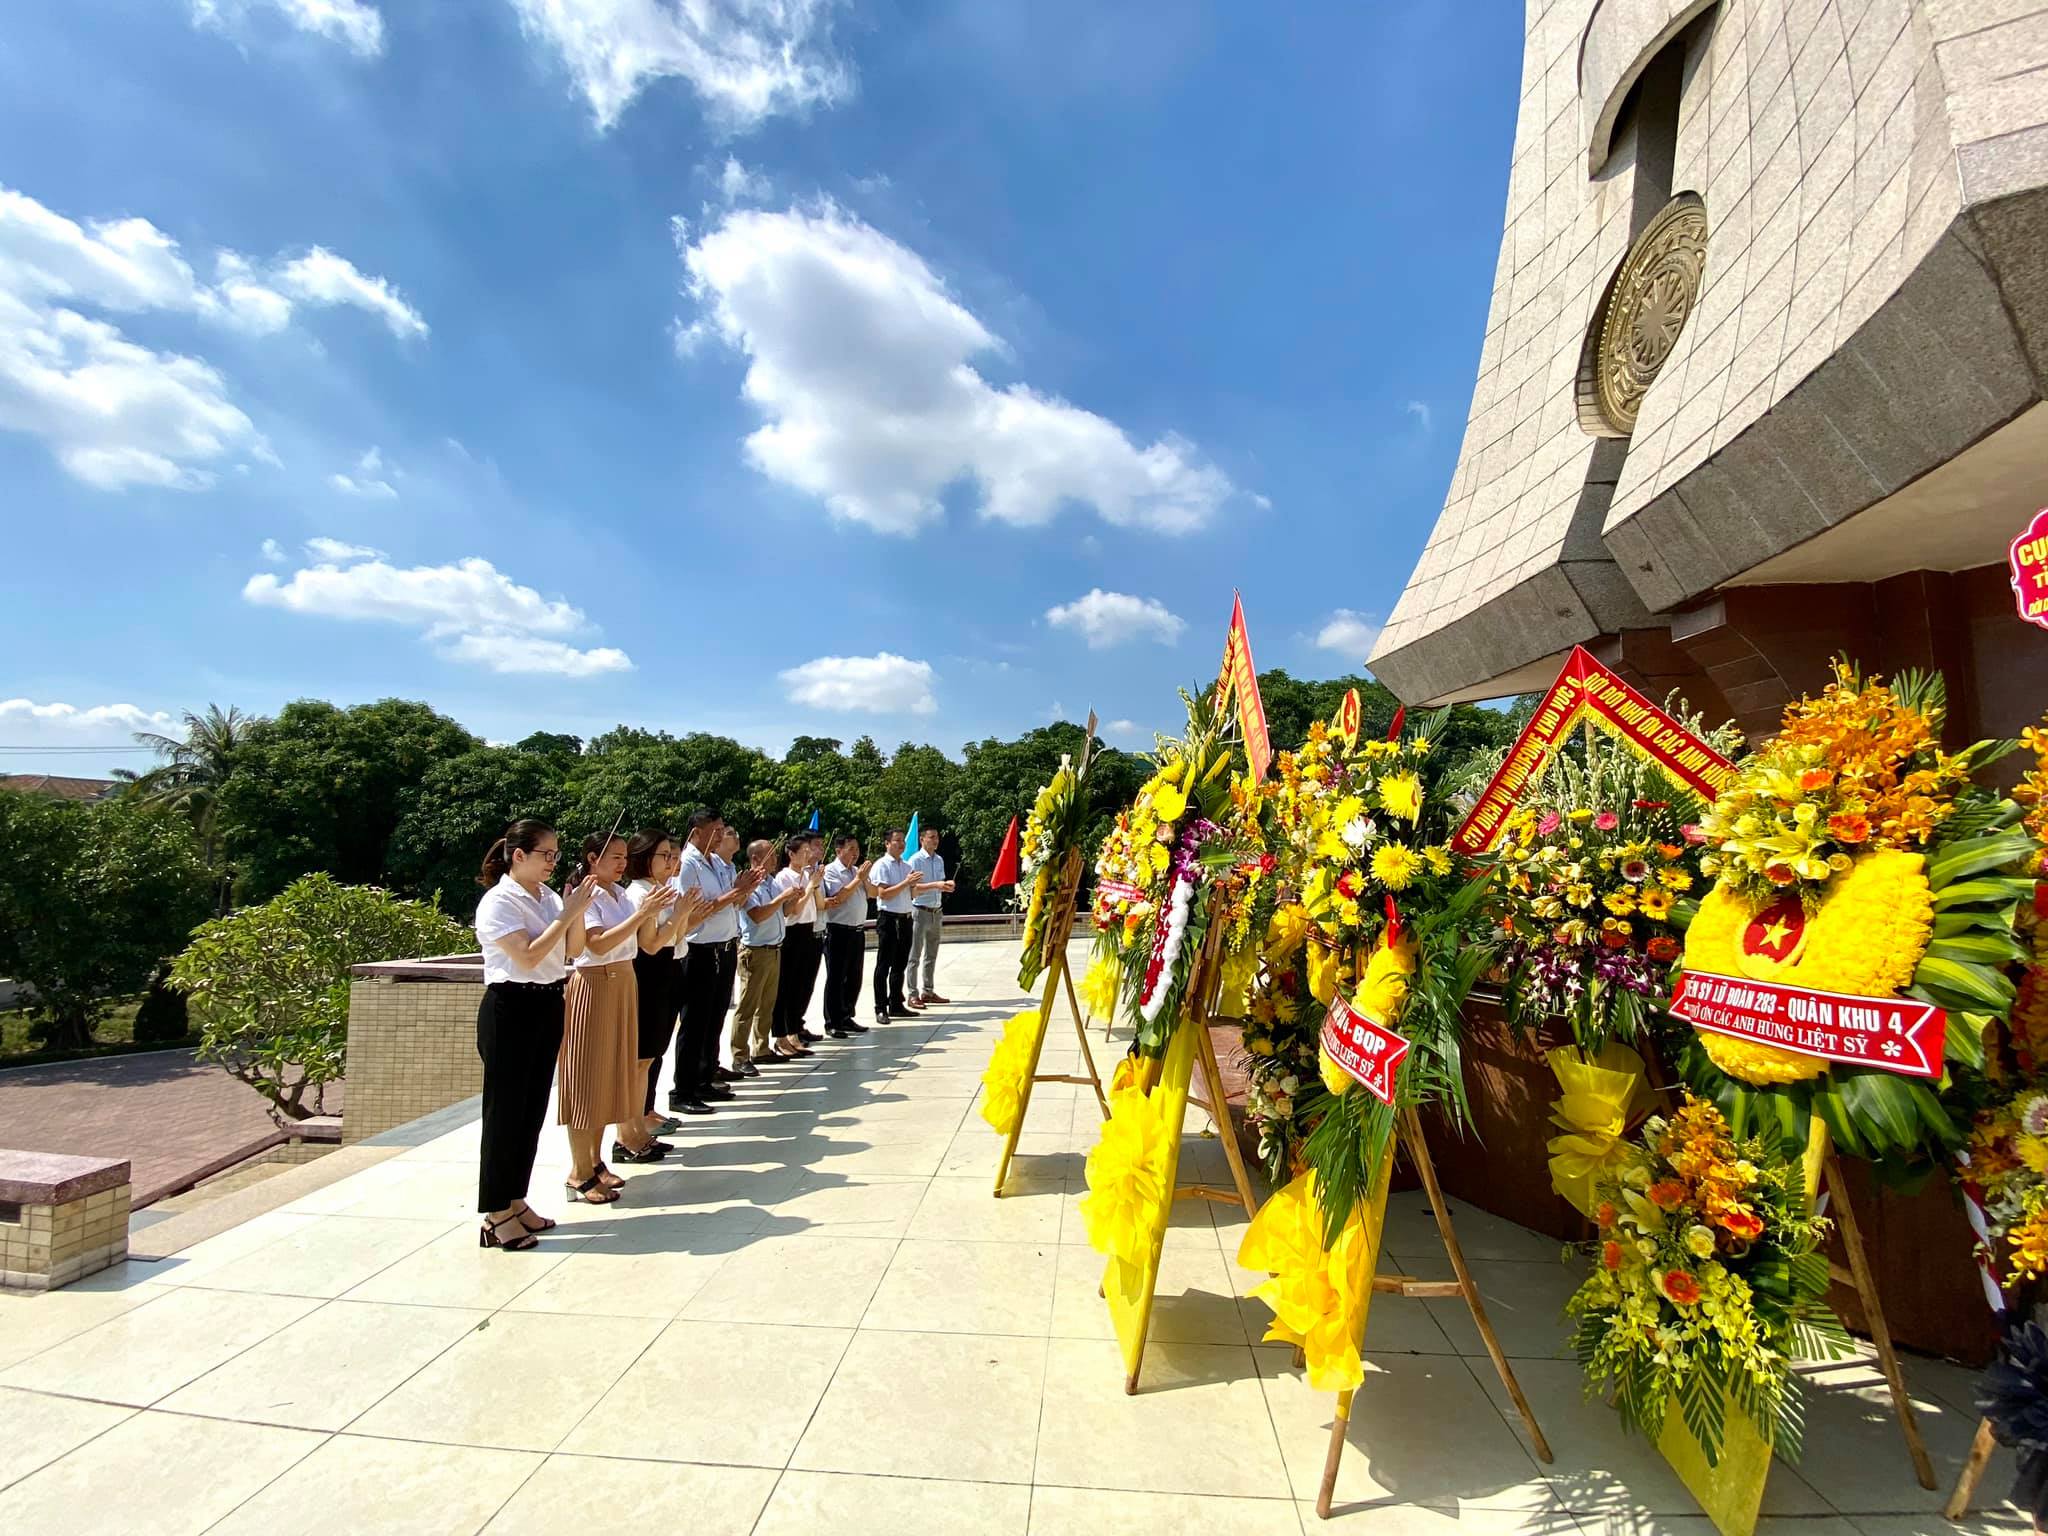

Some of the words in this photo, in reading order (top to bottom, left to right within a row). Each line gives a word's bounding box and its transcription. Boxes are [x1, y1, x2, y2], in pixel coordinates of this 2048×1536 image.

[2018, 535, 2048, 567] CỤ
[2032, 566, 2048, 588] TỈ
[1582, 672, 1610, 695] ĐỜI
[1598, 685, 1627, 708] ĐỜI
[1615, 699, 1654, 726] NHỚ
[1636, 716, 1664, 738] ƠN
[1652, 728, 1687, 754] CÁC
[1673, 746, 1711, 773] ANH
[1462, 827, 1485, 848] CTY
[1475, 802, 1504, 832] DỊCH
[1500, 733, 1546, 790] MOBIFONE
[1535, 709, 1560, 737] KHU
[1551, 684, 1576, 712] VỰC
[1565, 675, 1582, 690] 6
[1713, 1007, 1733, 1026] CÁC
[1731, 1014, 1755, 1033] ANH
[1757, 1016, 1794, 1042] HÙNG
[1797, 1026, 1838, 1052] LIỆT
[1843, 1033, 1868, 1055] SỸ
[1726, 984, 1755, 1010] ĐOÀN
[1753, 991, 1778, 1015] 283
[1788, 997, 1833, 1026] QUÂN
[1838, 1005, 1880, 1032] KHU
[1887, 1011, 1903, 1035] 4
[1352, 1023, 1387, 1055] BQP
